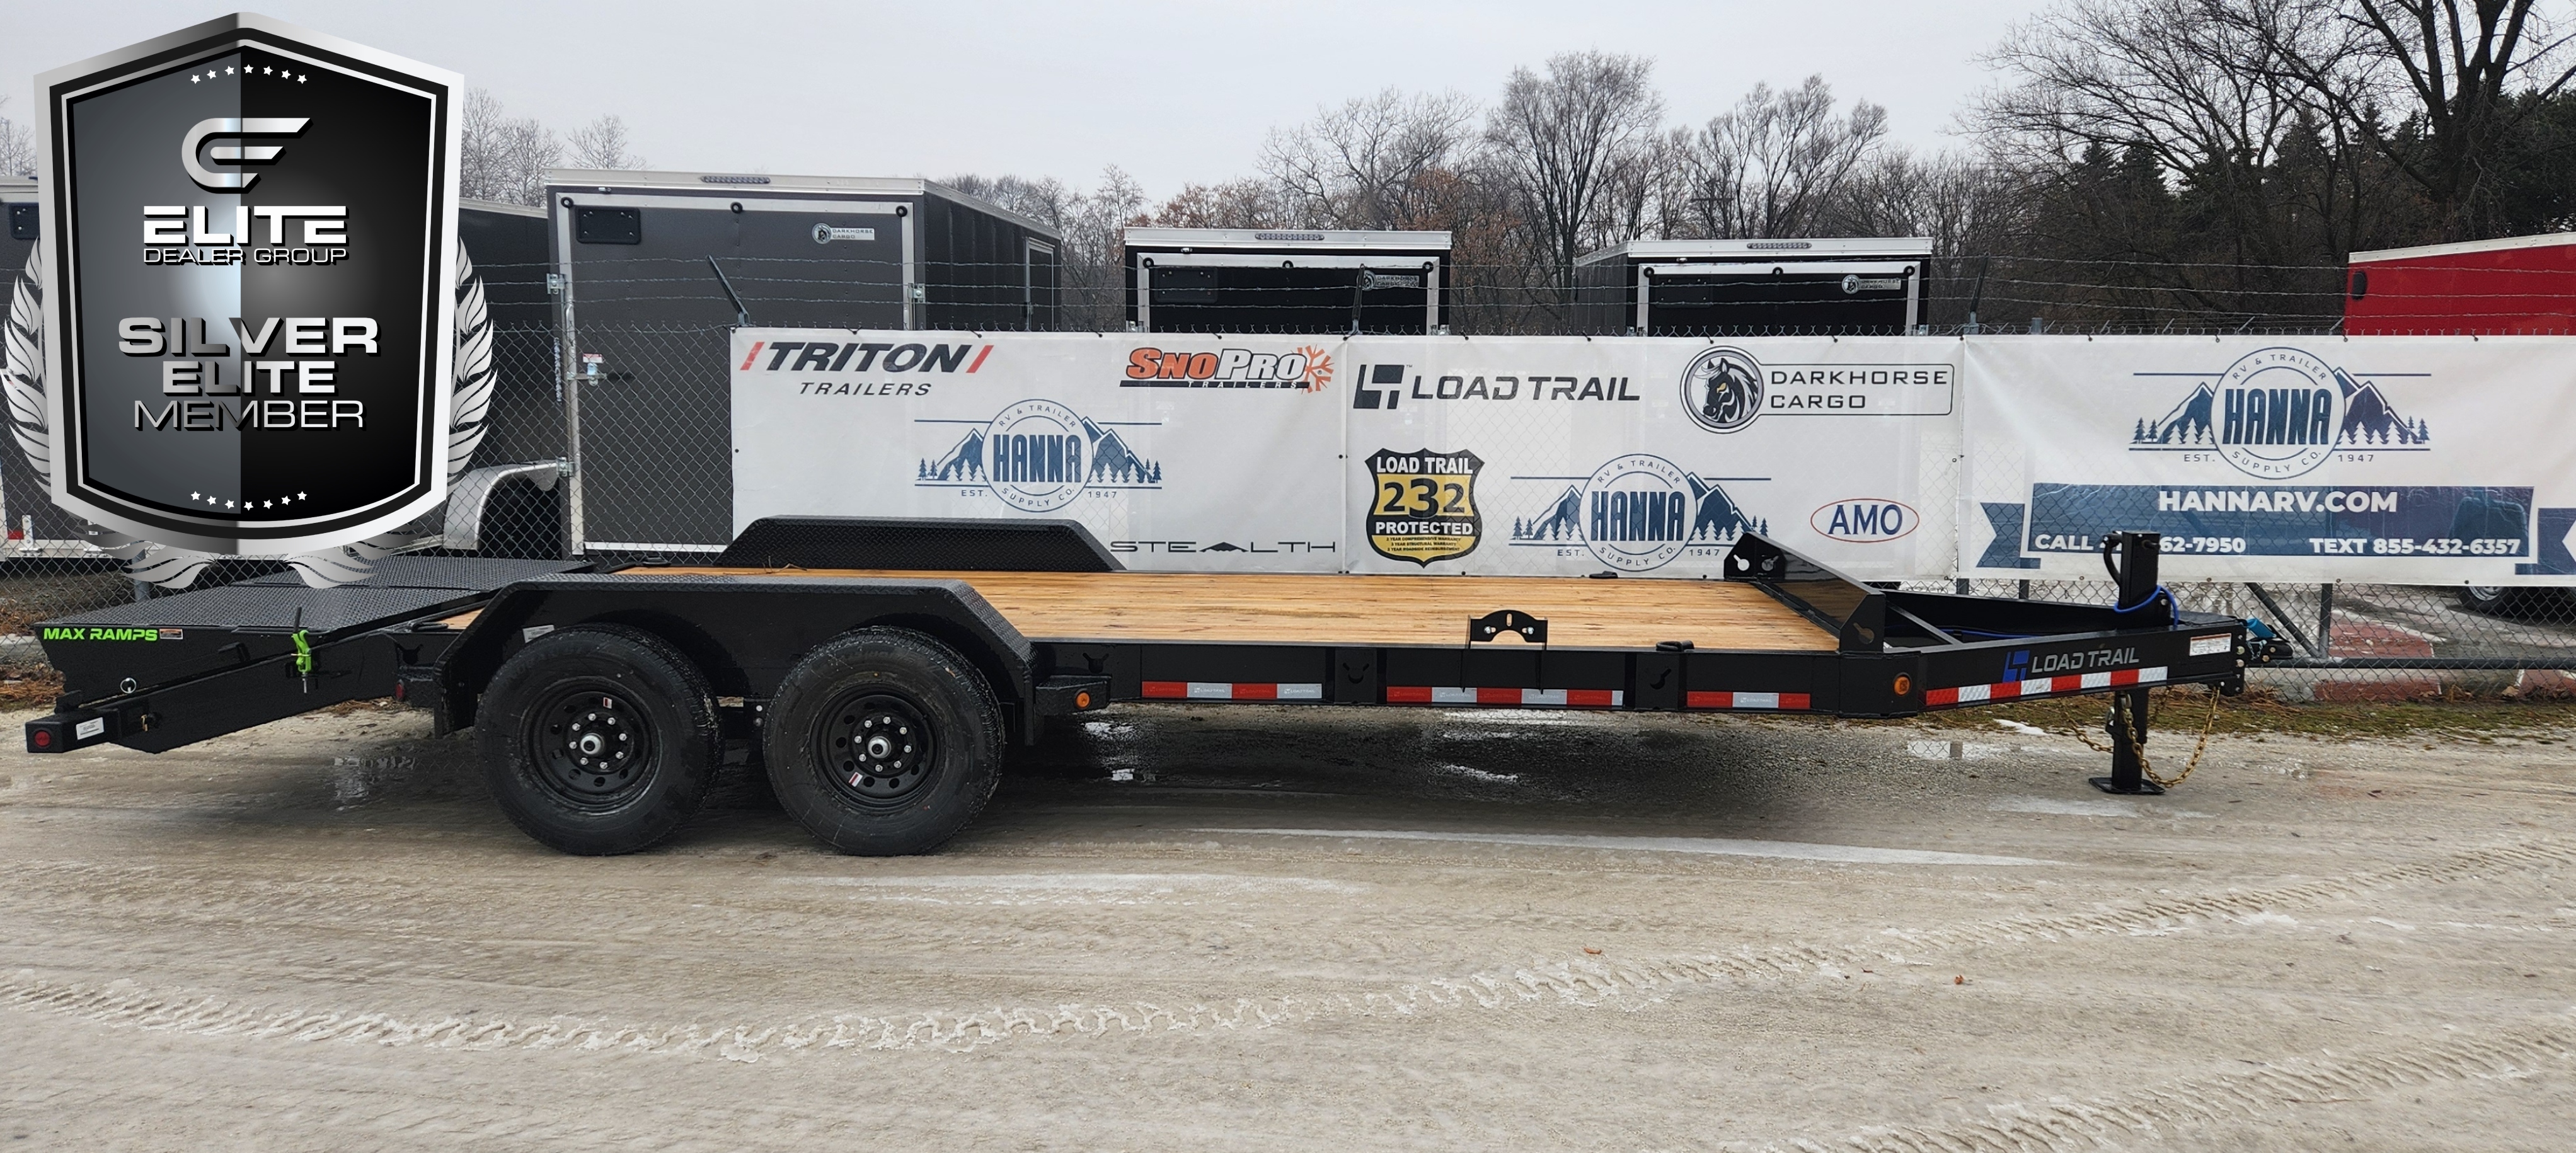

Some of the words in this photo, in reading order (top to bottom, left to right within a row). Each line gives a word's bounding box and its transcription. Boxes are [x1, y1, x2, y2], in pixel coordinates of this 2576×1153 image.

[766, 341, 972, 374] TRITON
[2232, 365, 2246, 380] RV
[2255, 357, 2262, 365] &
[2269, 354, 2326, 380] TRAILER
[1187, 381, 1297, 389] TRAILERS
[1770, 370, 1947, 385] DARKHORSE
[799, 382, 932, 396] TRAILERS
[1411, 375, 1519, 400] LOAD
[1527, 376, 1640, 401] TRAIL
[1770, 394, 1866, 410] CARGO
[998, 415, 1011, 427] RV
[1029, 404, 1076, 428] TRAILER
[2222, 388, 2333, 445] HANNA
[992, 433, 1082, 483] HANNA
[1376, 456, 1420, 473] LOAD
[1424, 457, 1474, 474] TRAIL
[2183, 454, 2215, 462] EST.
[2231, 450, 2291, 473] SUPPLY
[2301, 451, 2321, 466] CO.
[2337, 454, 2374, 462] 1947
[1597, 471, 1611, 483] RV
[1631, 460, 1681, 484] TRAILER
[961, 489, 988, 497] EST.
[1001, 487, 1051, 507] SUPPLY
[1058, 488, 1076, 502] CO.
[1088, 490, 1118, 499] 1947
[1383, 477, 1465, 519] 232
[2158, 490, 2398, 513] HANNARV.COM
[1590, 491, 1686, 542] HANNA
[1827, 503, 1903, 536] AMO
[1375, 521, 1474, 535] PROTECTED
[2034, 534, 2093, 551] CALL
[2309, 537, 2367, 554] TEXT
[2372, 538, 2521, 555] 855-432-6357
[1599, 546, 1650, 566] SUPPLY
[1658, 546, 1676, 560] CO.
[43, 628, 86, 640] MAX
[89, 628, 158, 641] RAMPS
[2031, 651, 2085, 674] LOAD
[2087, 647, 2140, 668] TRAIL
